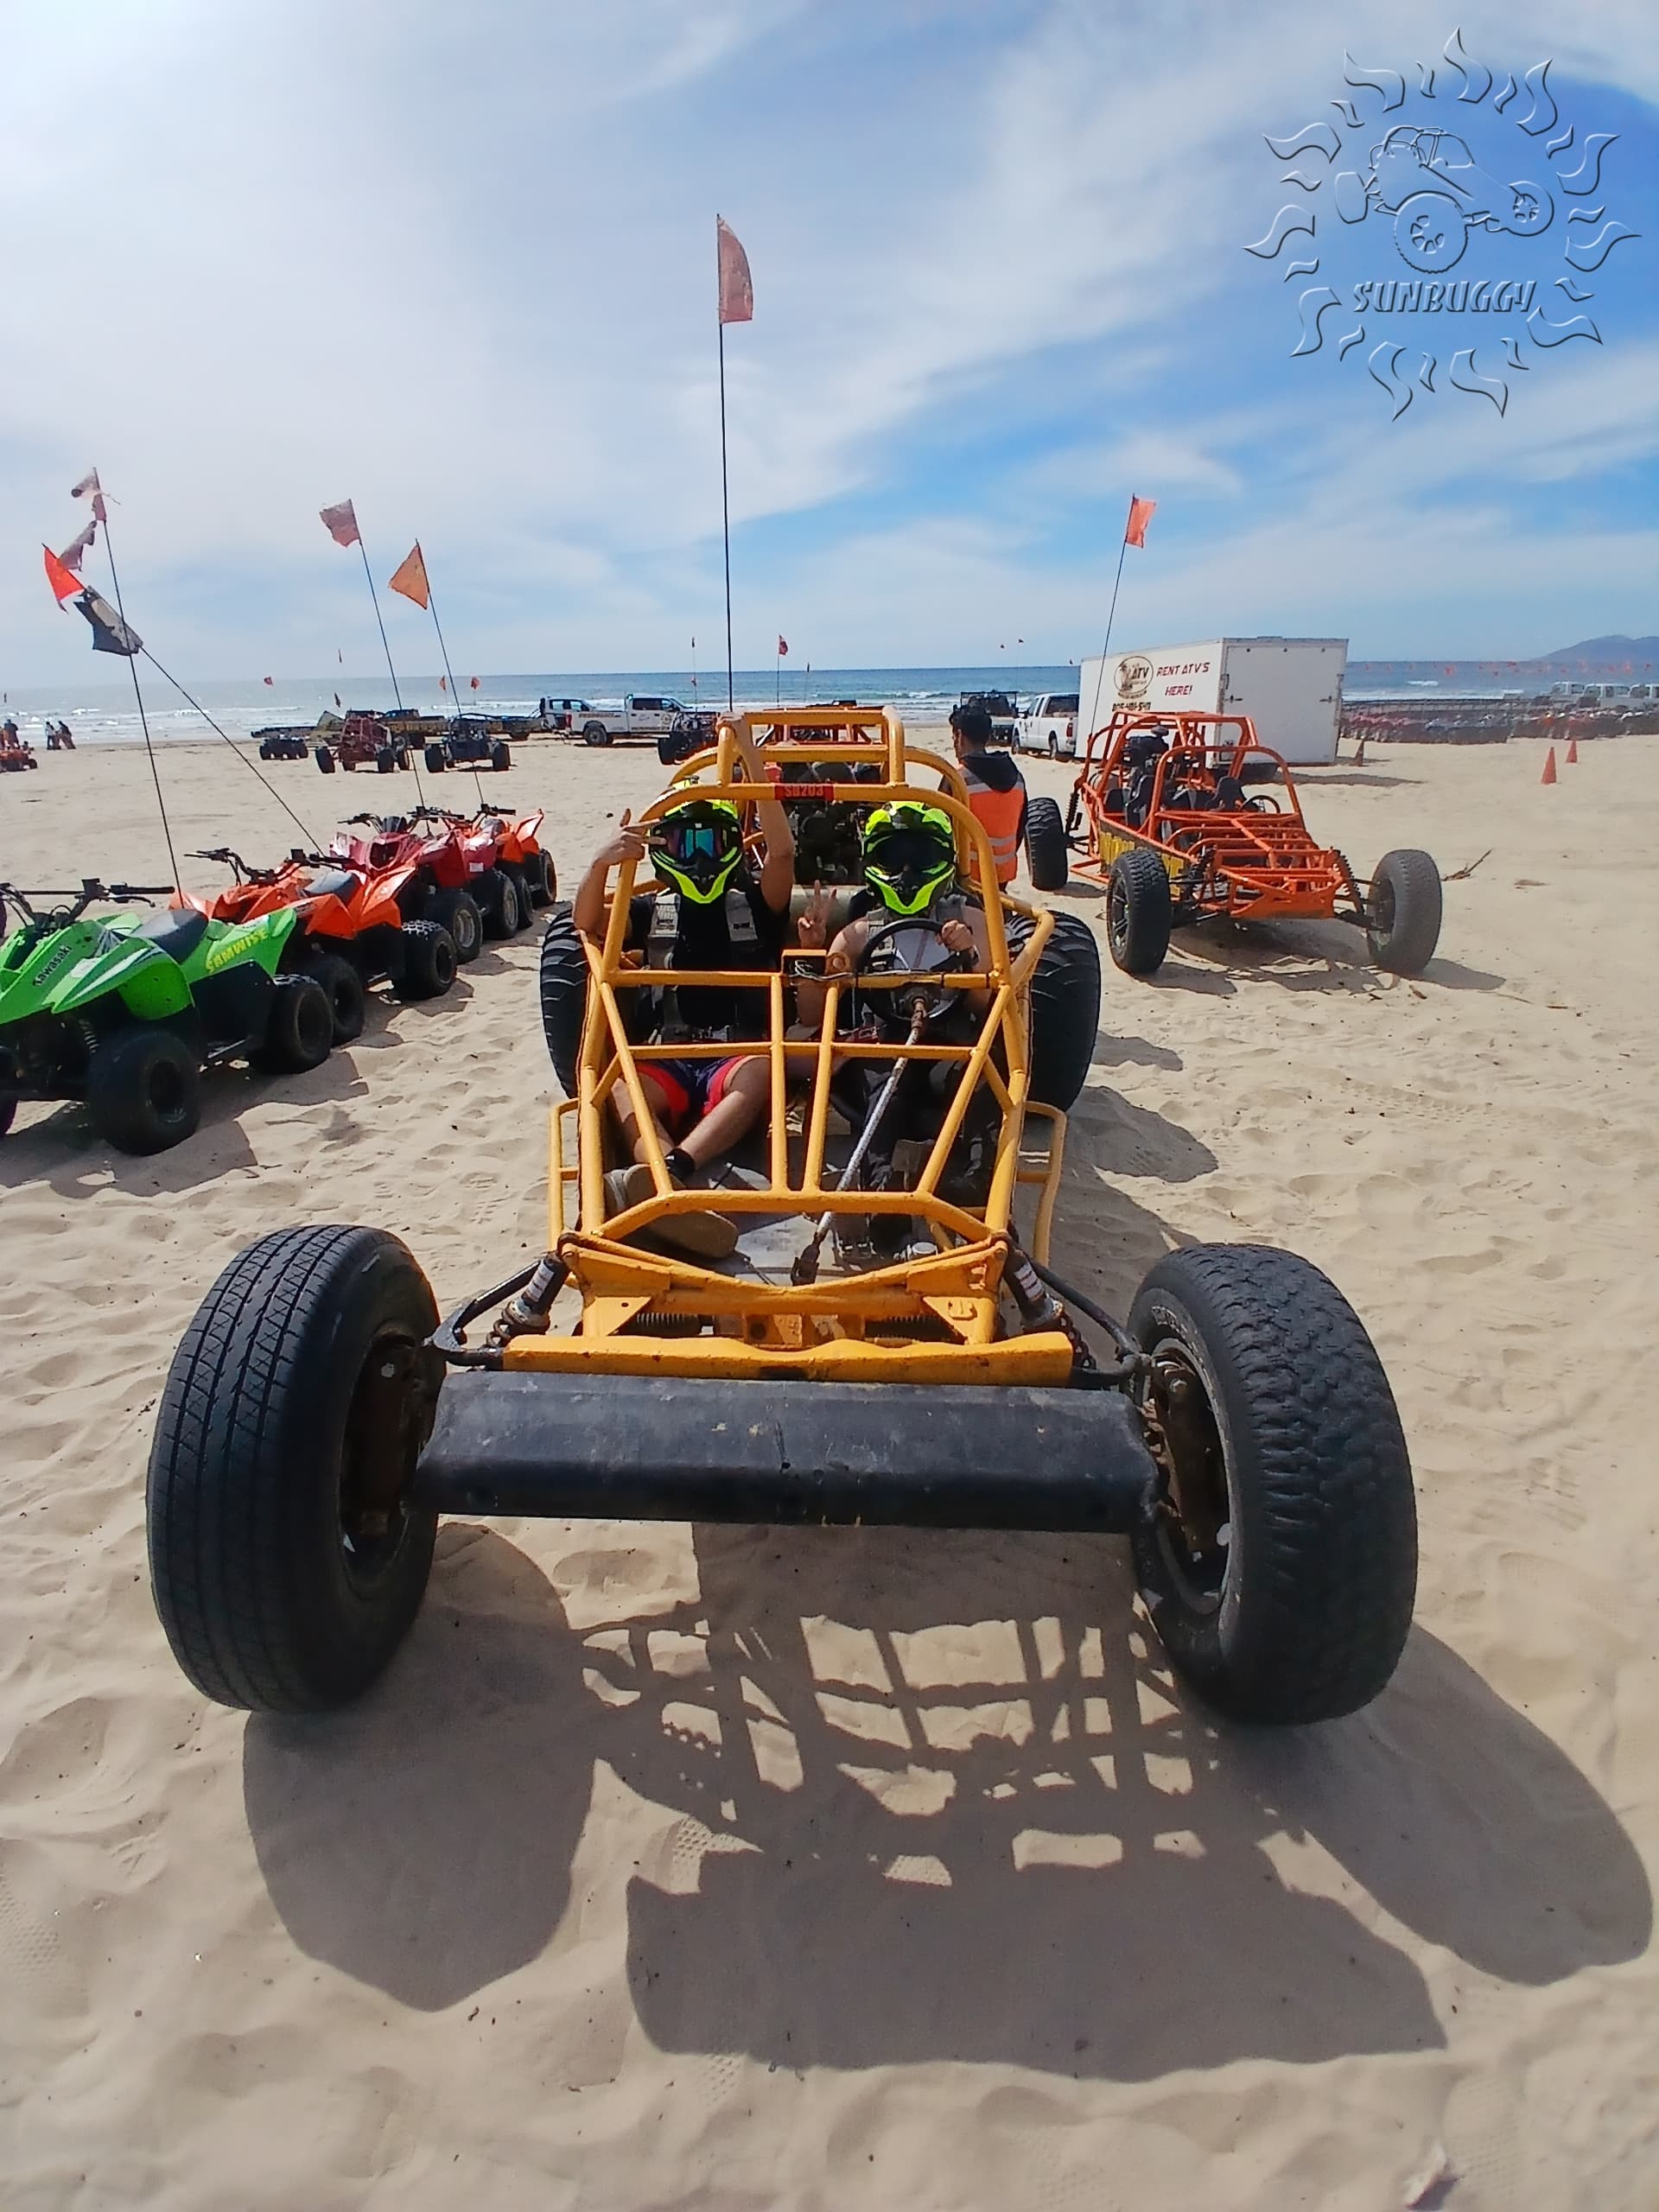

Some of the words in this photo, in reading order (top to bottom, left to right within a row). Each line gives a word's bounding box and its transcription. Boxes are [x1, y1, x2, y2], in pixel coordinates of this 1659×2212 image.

[1131, 667, 1149, 680] ATV
[1156, 664, 1180, 677] RENT
[1165, 685, 1193, 696] HERE!
[206, 928, 269, 974] SAMWISE
